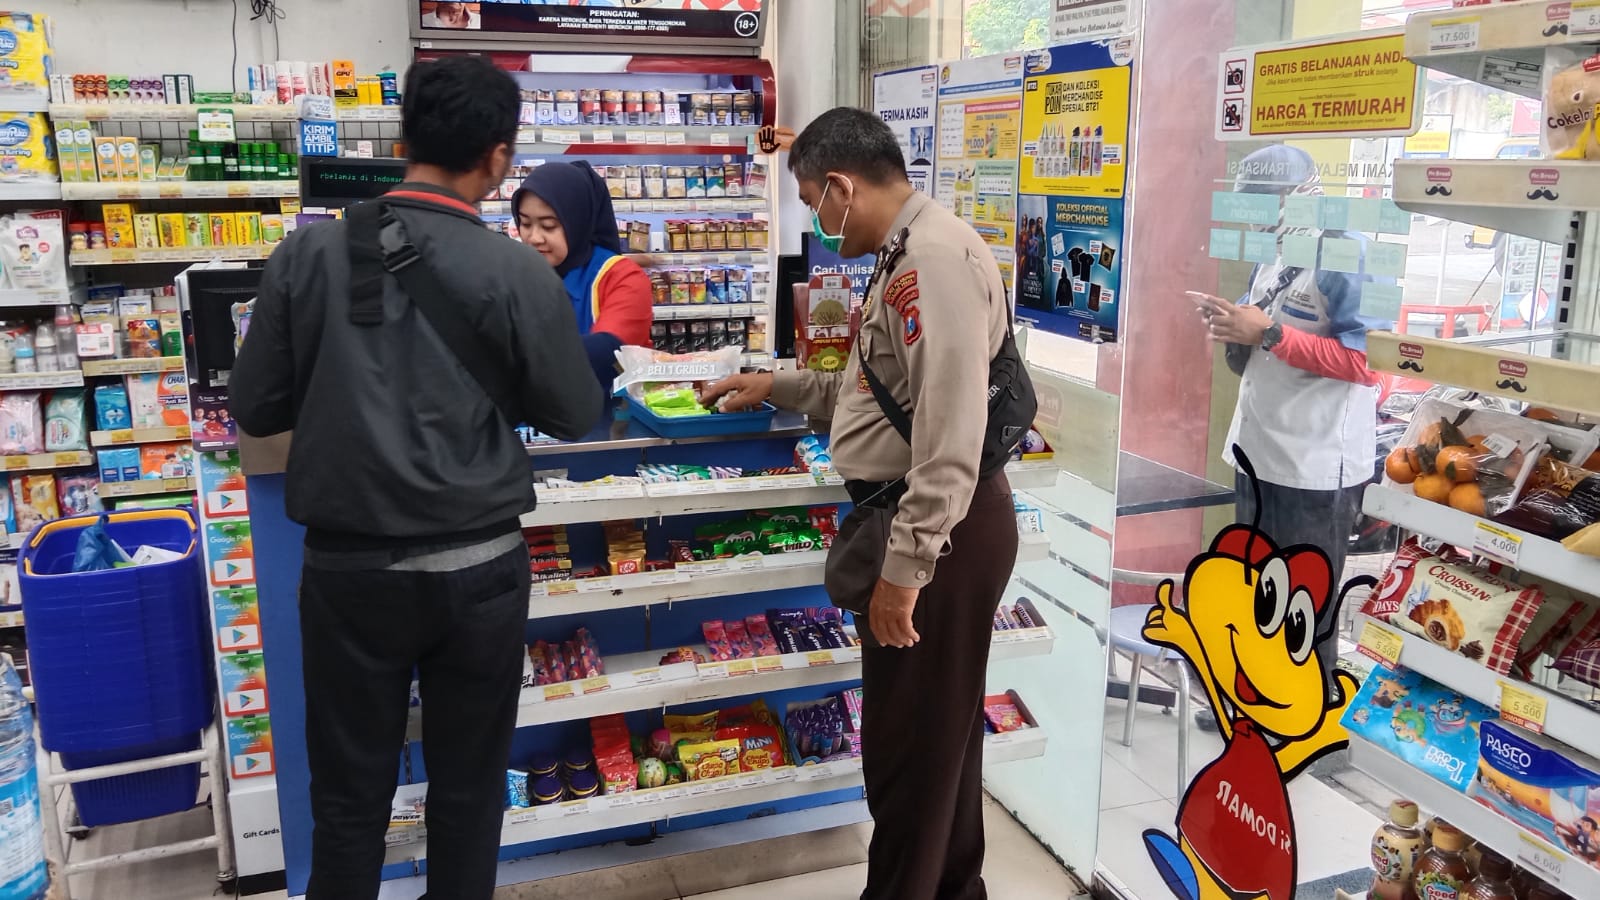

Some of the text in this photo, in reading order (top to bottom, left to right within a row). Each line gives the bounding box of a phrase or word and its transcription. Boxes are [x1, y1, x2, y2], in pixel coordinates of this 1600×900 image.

[590, 9, 639, 18] PERINGATAN:
[737, 20, 755, 29] 18+
[1440, 32, 1470, 42] 17.500
[1259, 50, 1409, 77] GRATIS BELANJAAN ANDA
[1353, 67, 1375, 78] struk
[1075, 80, 1100, 91] KOLEKSI
[1062, 91, 1103, 102] MERCHANDISE
[1061, 102, 1085, 113] SPESIAL
[1256, 96, 1406, 122] HARGA TERMURAH
[879, 106, 929, 122] TERIMA KASIH
[1547, 108, 1592, 129] Cokela
[303, 124, 334, 135] KIRIM
[304, 134, 332, 143] AMBIL
[305, 143, 335, 155] TITIP
[373, 175, 403, 183] Indomar
[1056, 203, 1108, 215] KOLEKSI OFFICIAL
[1055, 214, 1109, 226] MERCHANDISE
[812, 263, 877, 275] Cari Tulisa
[647, 364, 666, 375] BELI
[166, 375, 185, 385] CHAR
[784, 541, 812, 552] MILO
[1490, 537, 1517, 555] 4.000
[1373, 600, 1400, 613] DAYS
[1513, 701, 1542, 720] 5.500
[1486, 733, 1532, 769] PASEO
[1423, 745, 1466, 785] Tessa
[243, 827, 280, 840] Gift Cards
[1533, 852, 1561, 874] 6.000
[1426, 885, 1457, 899] Good
